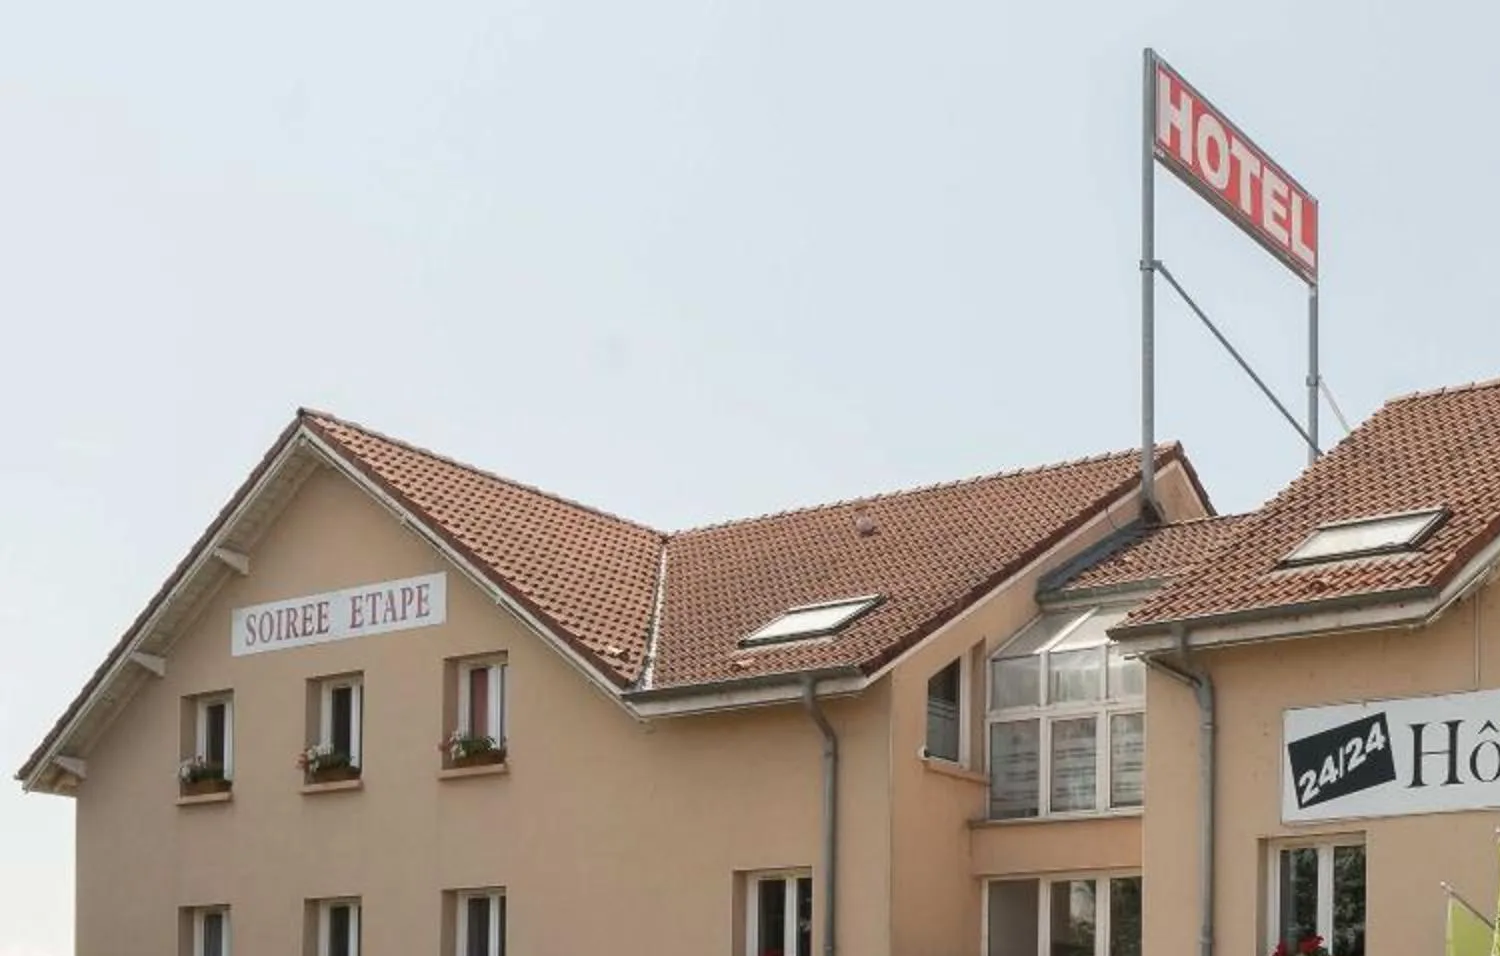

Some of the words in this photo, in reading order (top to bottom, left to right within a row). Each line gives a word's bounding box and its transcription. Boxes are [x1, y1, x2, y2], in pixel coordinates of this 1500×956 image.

[1158, 72, 1315, 269] HOTEL
[245, 602, 329, 645] SOIREE
[350, 584, 430, 629] ETAPE
[1299, 721, 1385, 803] 24/24
